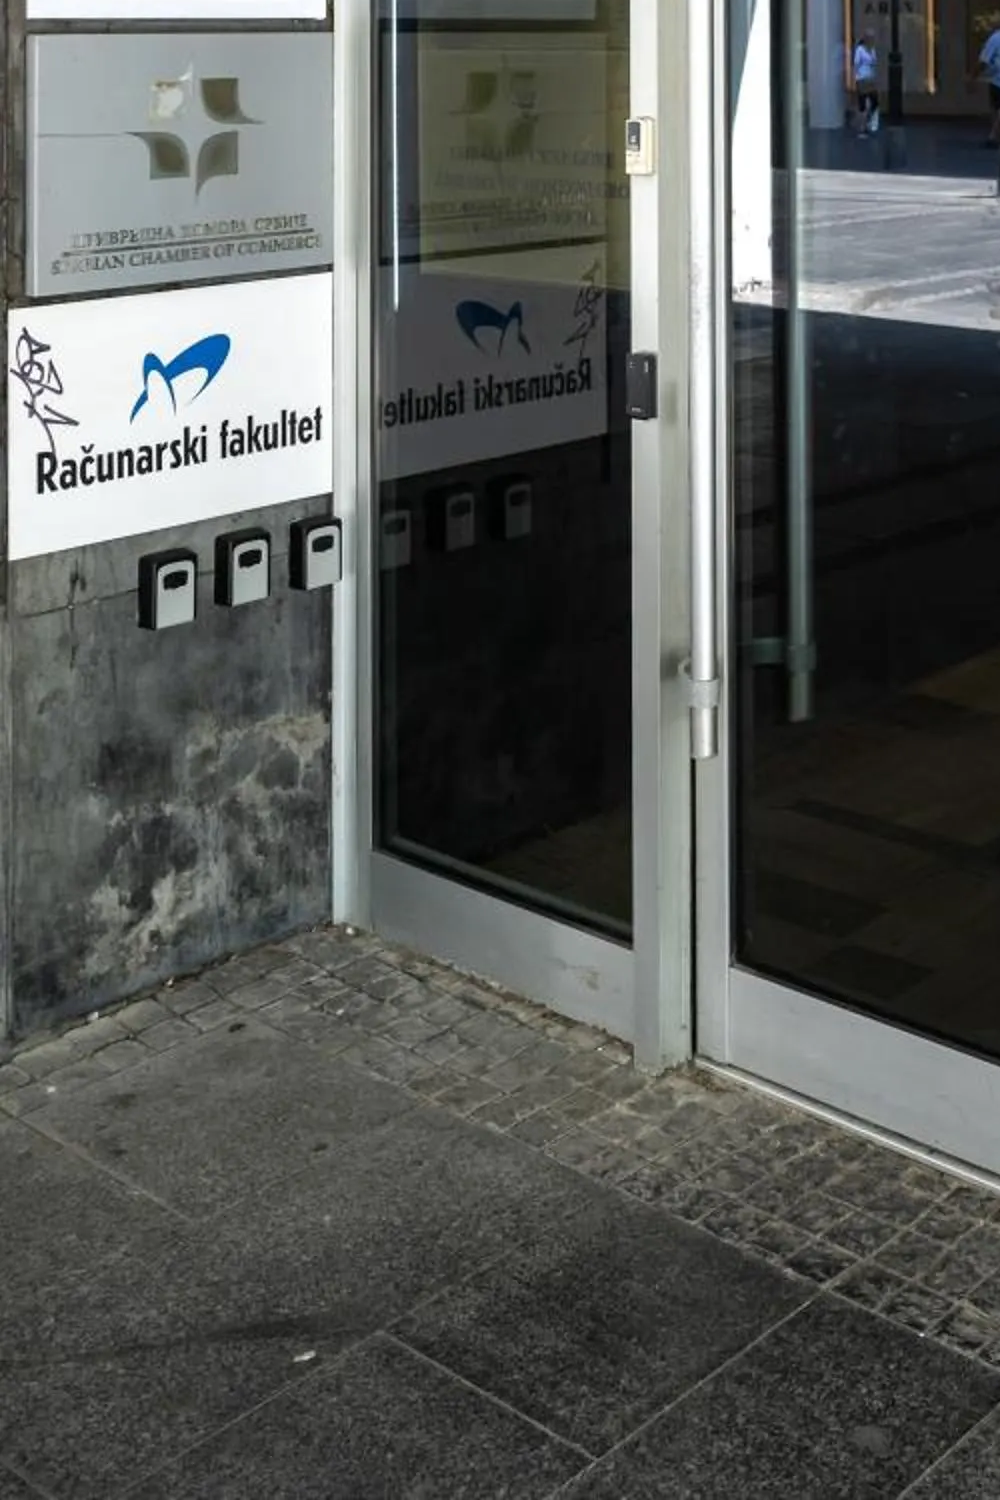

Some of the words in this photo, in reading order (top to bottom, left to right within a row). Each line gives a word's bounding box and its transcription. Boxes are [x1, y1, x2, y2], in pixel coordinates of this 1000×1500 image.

[128, 245, 210, 267] CHAMBER
[36, 426, 208, 494] Računarski
[220, 406, 323, 459] fakultet
